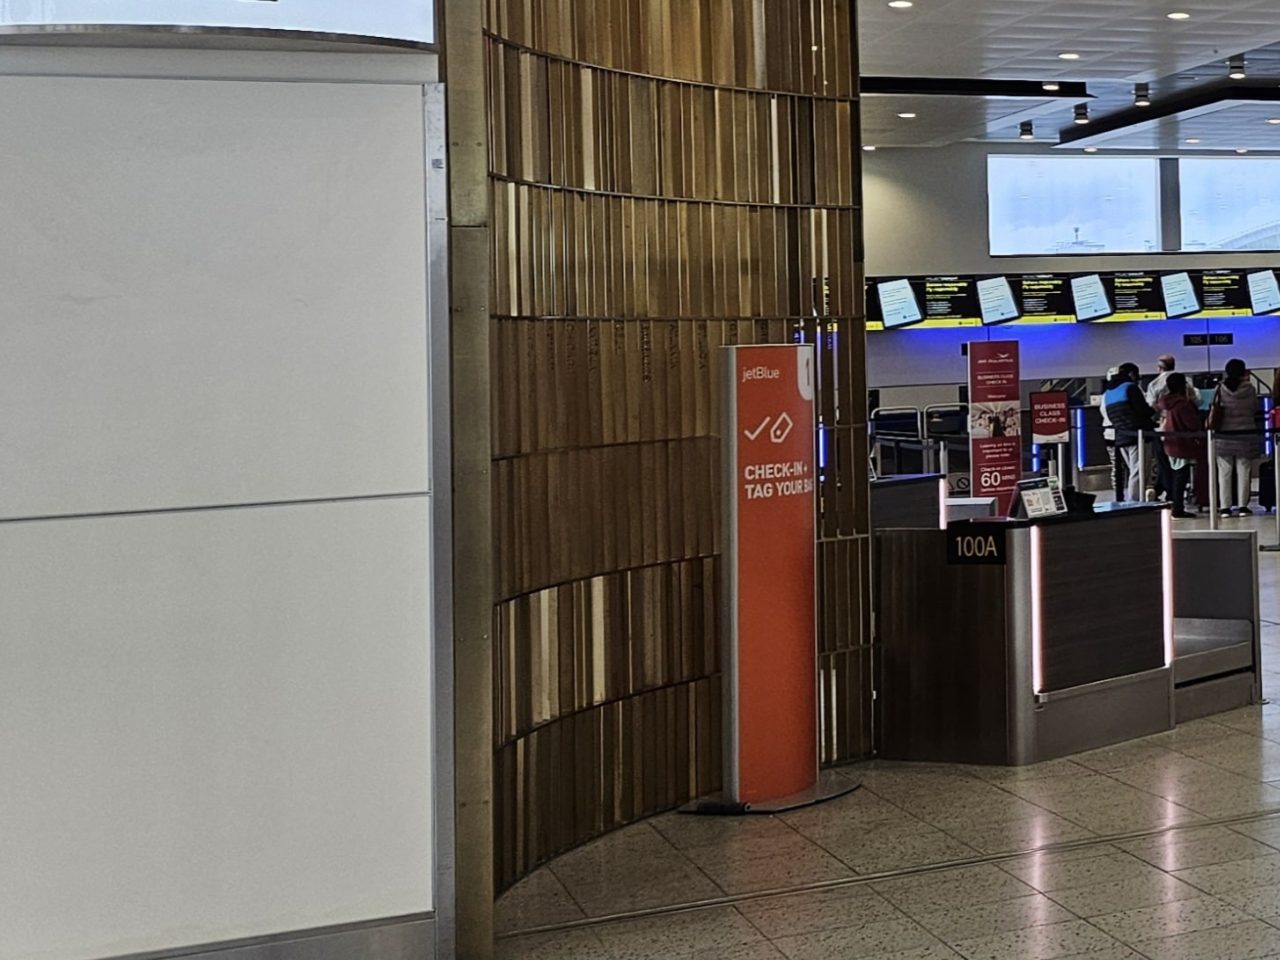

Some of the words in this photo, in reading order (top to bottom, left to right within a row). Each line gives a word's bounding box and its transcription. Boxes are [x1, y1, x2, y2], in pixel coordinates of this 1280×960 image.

[742, 366, 780, 382] jetBlue
[744, 461, 804, 480] CHECK-IN
[981, 472, 1000, 487] 60
[744, 483, 774, 499] TAG
[775, 480, 803, 497] YOUR
[955, 535, 998, 557] 100A
